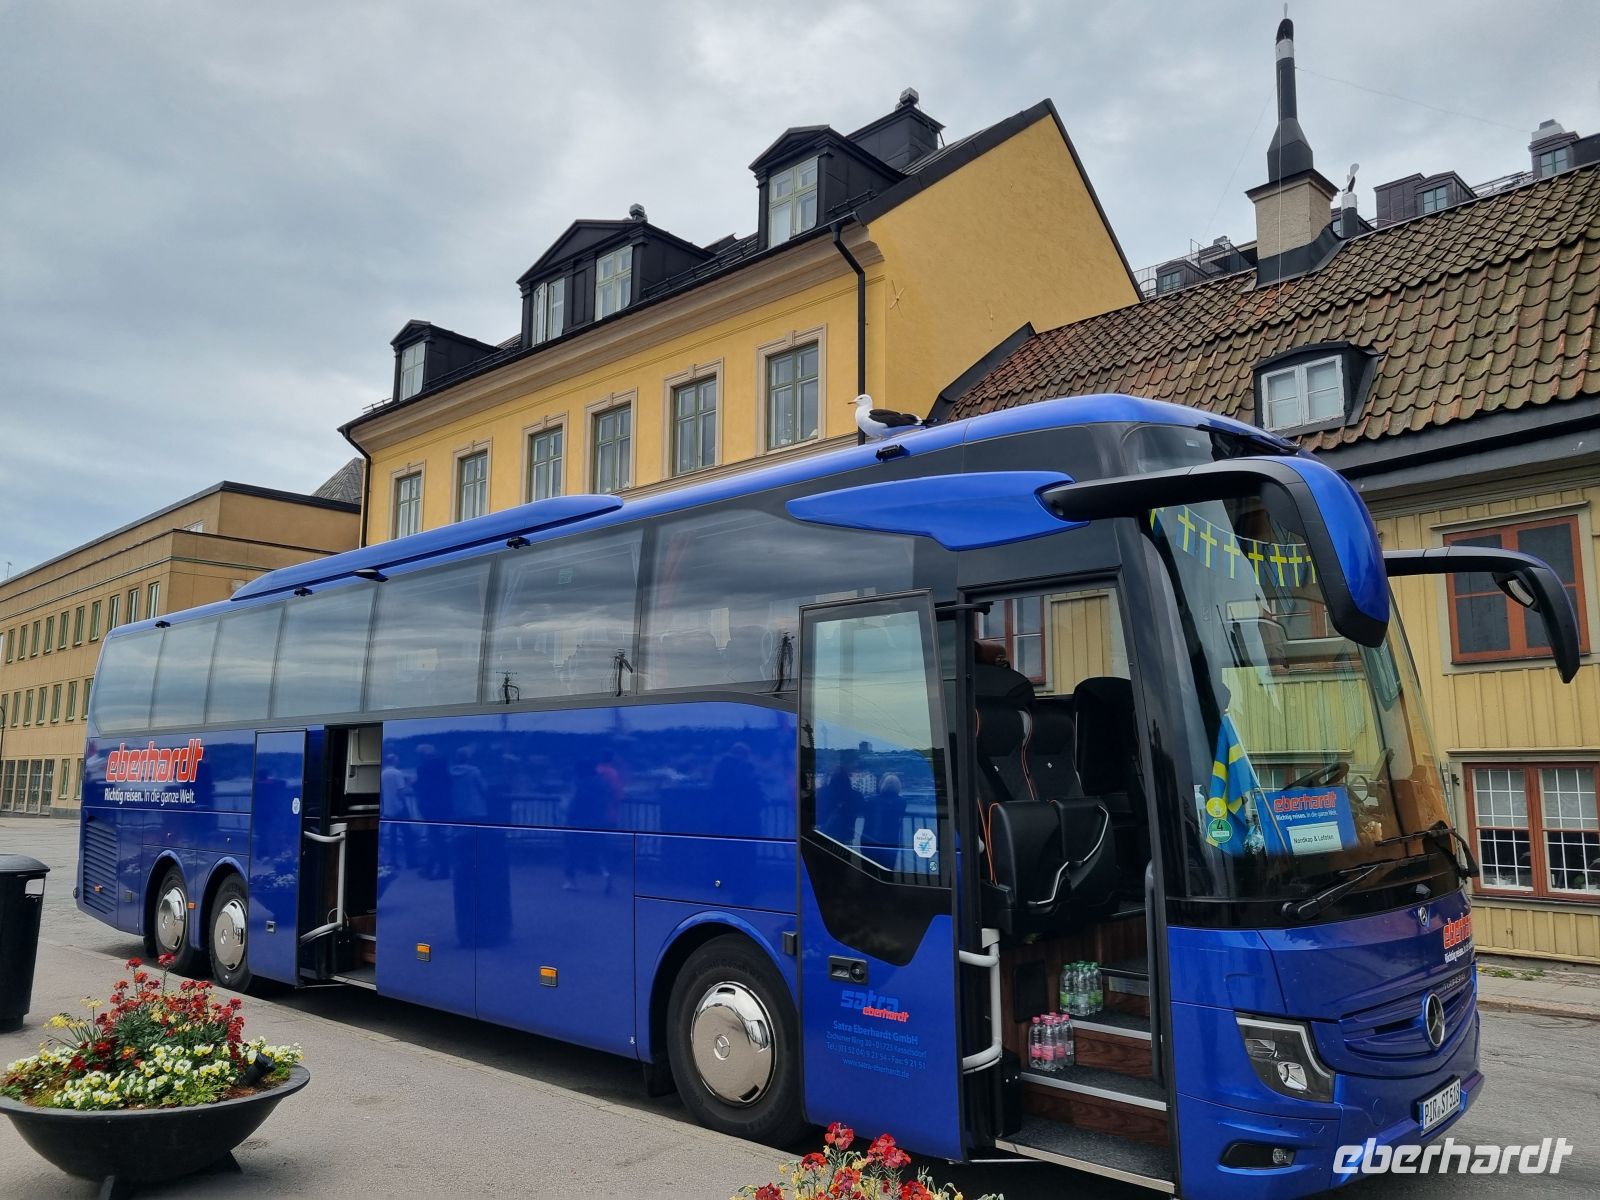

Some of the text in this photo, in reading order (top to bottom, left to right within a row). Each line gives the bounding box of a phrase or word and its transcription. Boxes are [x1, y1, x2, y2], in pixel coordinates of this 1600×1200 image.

[106, 739, 203, 782] eberhardt
[104, 788, 196, 806] Richtig reisen. In die ganze Welt.
[1274, 791, 1337, 812] eberhardt
[1216, 820, 1223, 831] 4
[1294, 836, 1313, 844] Nordkap
[840, 990, 899, 1012] satra
[863, 1006, 910, 1022] eberhardt
[833, 1020, 919, 1045] Satra Eberhardt GmbH
[1425, 1099, 1437, 1125] PIR
